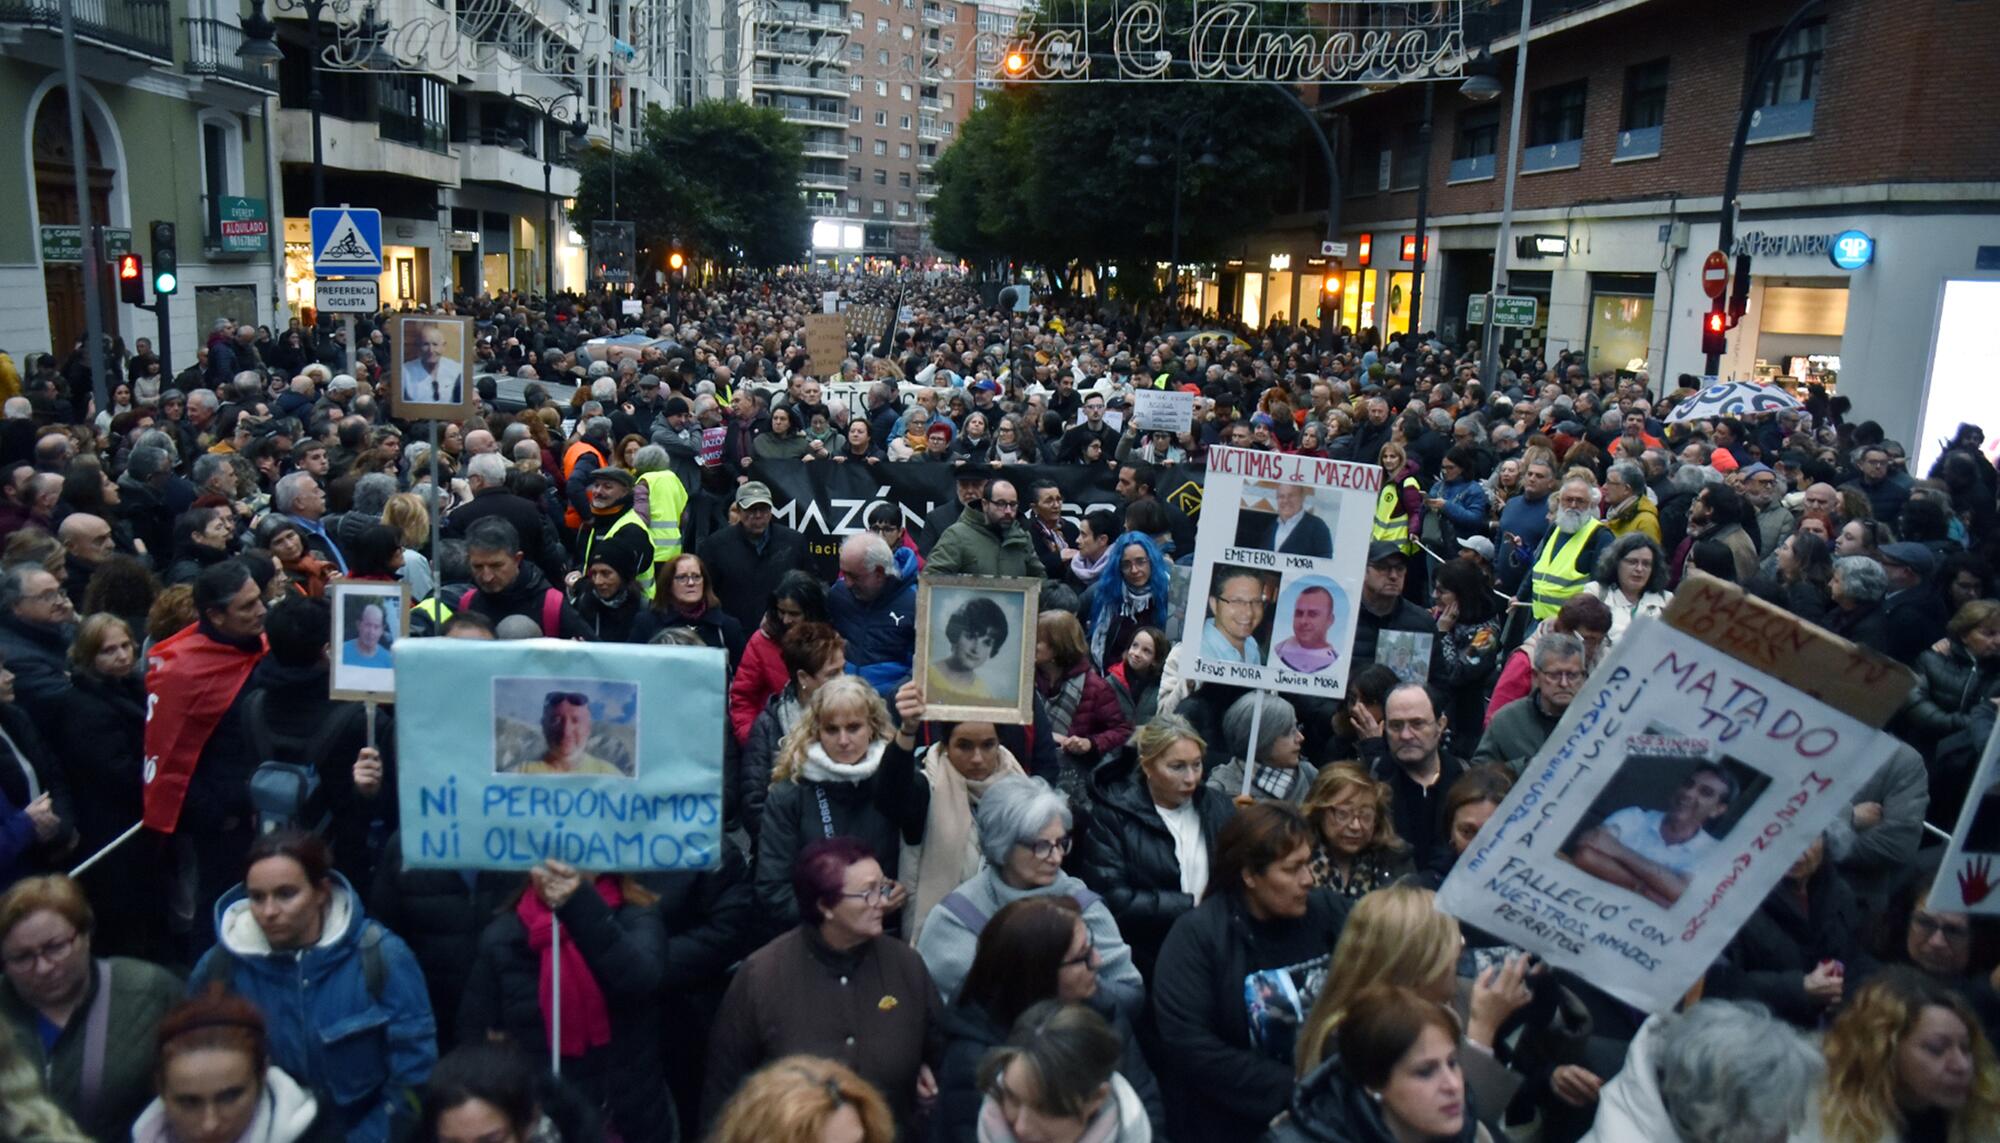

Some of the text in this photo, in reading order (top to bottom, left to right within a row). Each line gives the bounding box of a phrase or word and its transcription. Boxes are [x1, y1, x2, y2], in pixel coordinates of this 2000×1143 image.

[226, 221, 264, 234] ALQUILADO
[317, 286, 376, 295] PREFERENCIA
[328, 297, 366, 306] CICLISTA
[1209, 447, 1283, 480] VICTIMAS
[1314, 461, 1382, 492] MAZON
[1224, 548, 1314, 569] EMETERIO MORA
[1231, 666, 1261, 680] MORA
[1314, 676, 1339, 689] MORA
[1653, 650, 1839, 757] MATADO
[482, 785, 719, 826] PERDONAMOS
[1484, 877, 1590, 938] NUESTROS
[1628, 917, 1674, 947] CON
